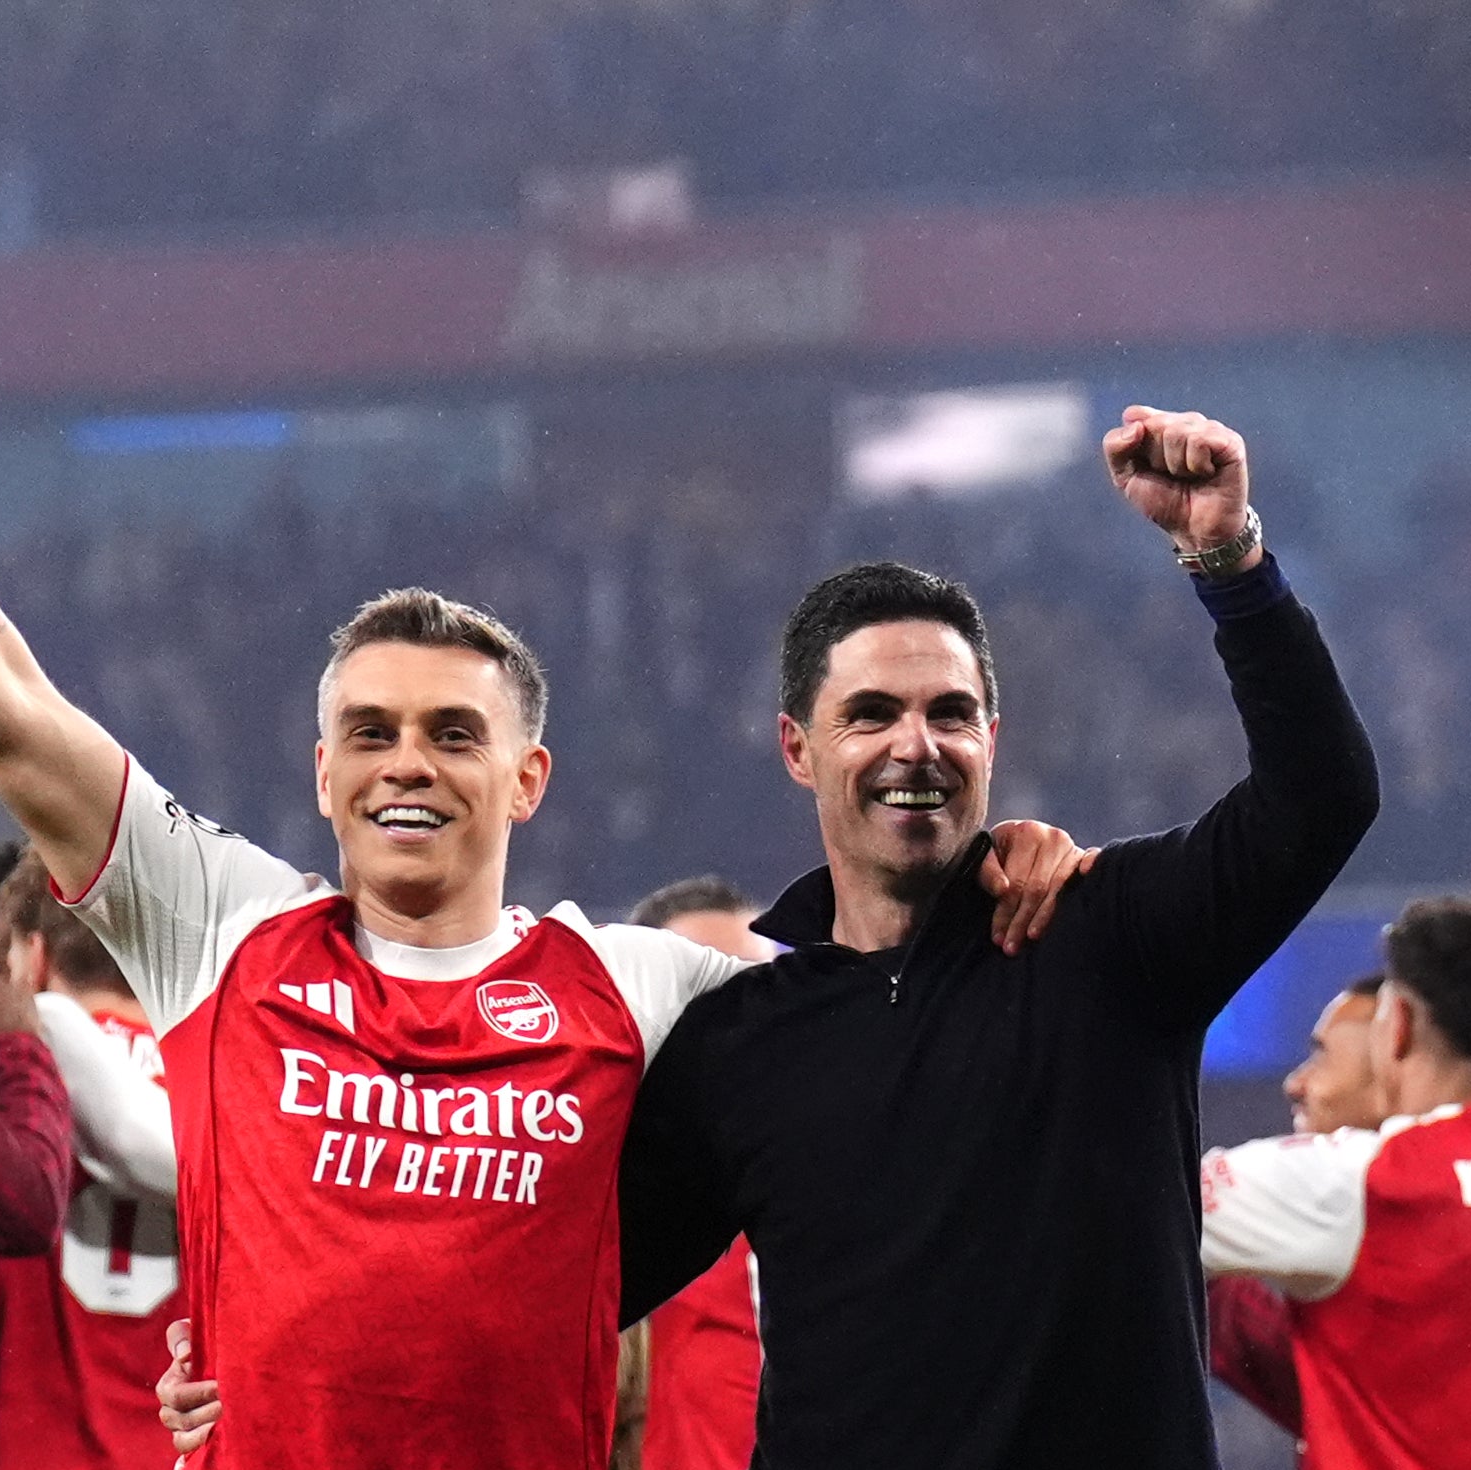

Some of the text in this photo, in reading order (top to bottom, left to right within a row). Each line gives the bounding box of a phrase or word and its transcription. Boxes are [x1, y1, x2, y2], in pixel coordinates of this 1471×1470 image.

[488, 991, 539, 1010] Arsenal
[279, 1048, 584, 1144] Emirates
[312, 1130, 544, 1205] FLY BETTER
